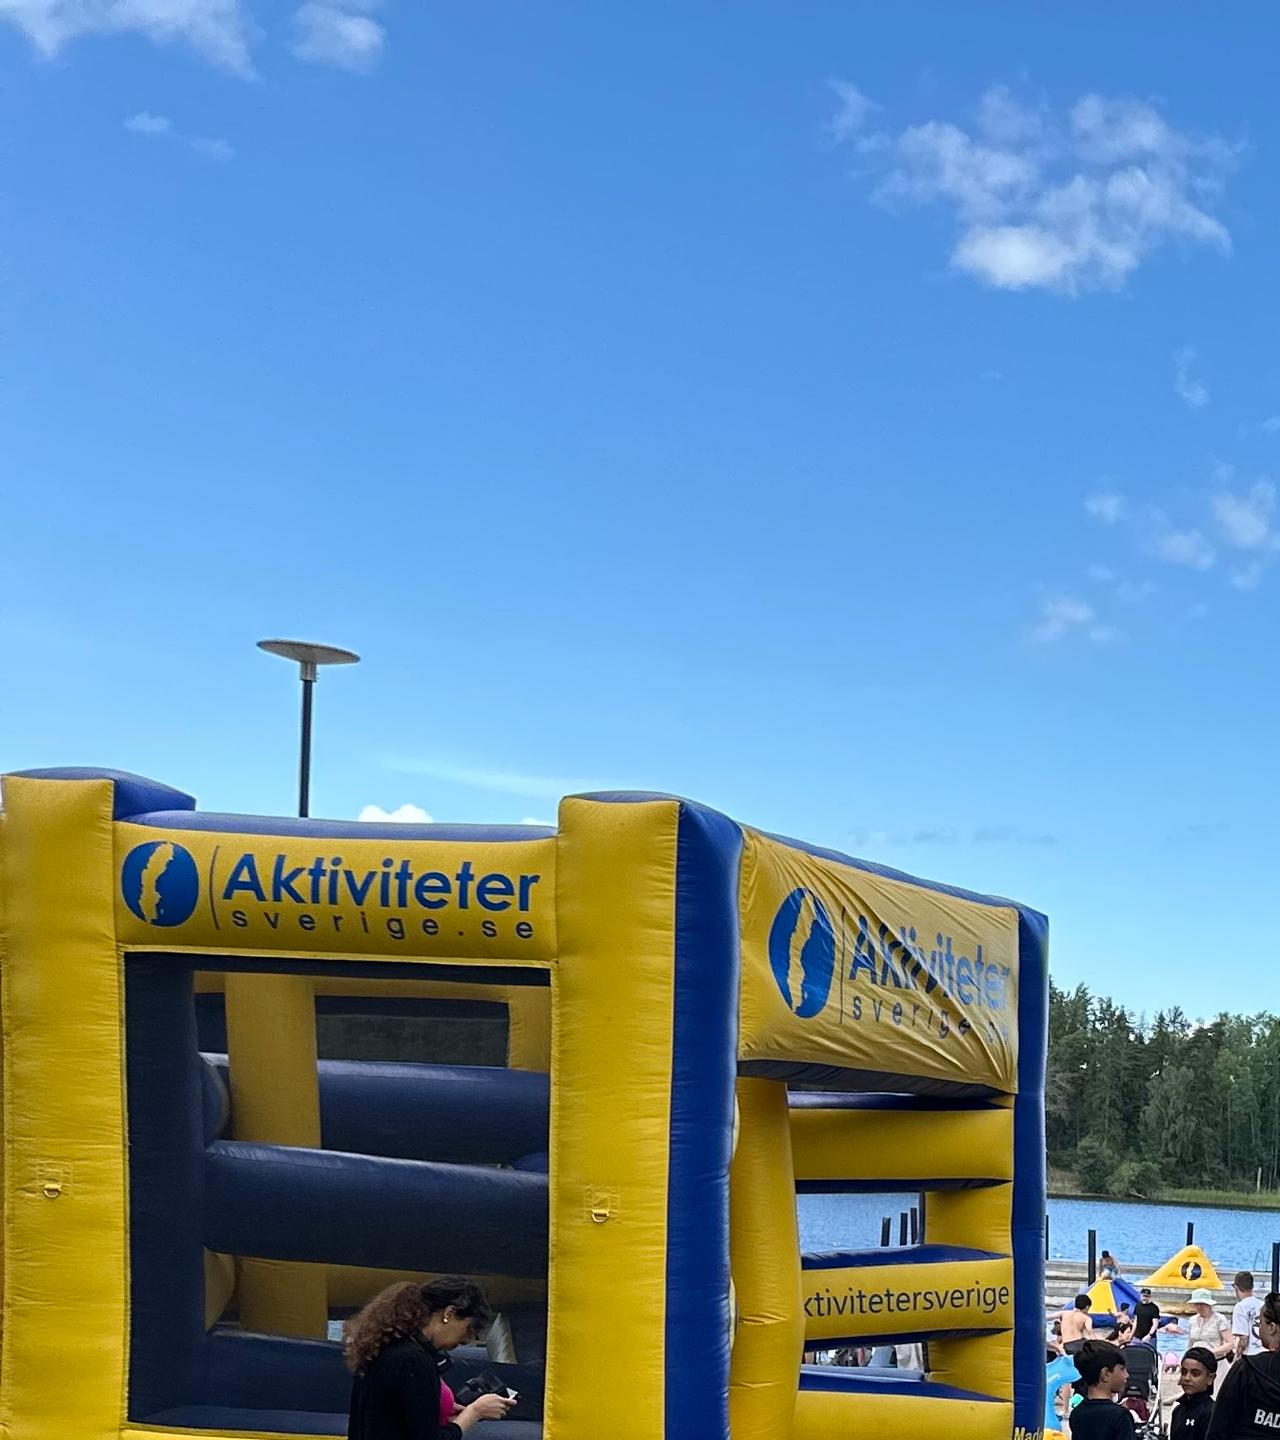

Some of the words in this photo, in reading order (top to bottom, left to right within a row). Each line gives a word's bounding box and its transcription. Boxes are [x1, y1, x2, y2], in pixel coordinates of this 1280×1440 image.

[223, 853, 541, 912] Aktiviteter
[231, 910, 534, 940] sverige.se
[803, 1280, 1010, 1317] ktivitetersverige
